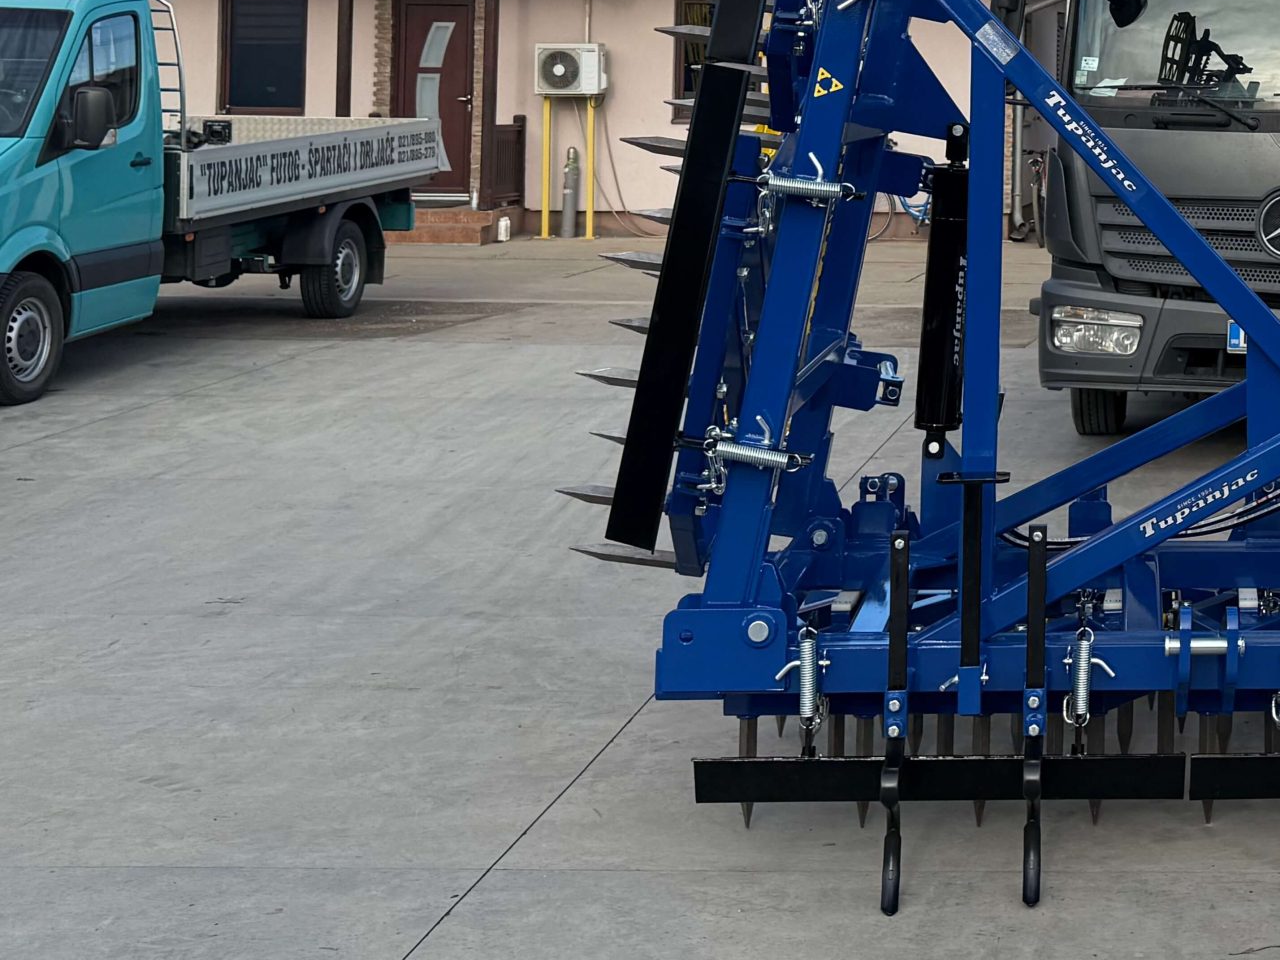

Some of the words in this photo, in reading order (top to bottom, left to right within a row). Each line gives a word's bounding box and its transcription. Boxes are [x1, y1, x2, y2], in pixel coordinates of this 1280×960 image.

[1045, 90, 1136, 191] Tupanjac
[270, 149, 300, 186] FUTOG
[1140, 469, 1258, 537] Tupanjac
[1176, 496, 1196, 510] SINCE
